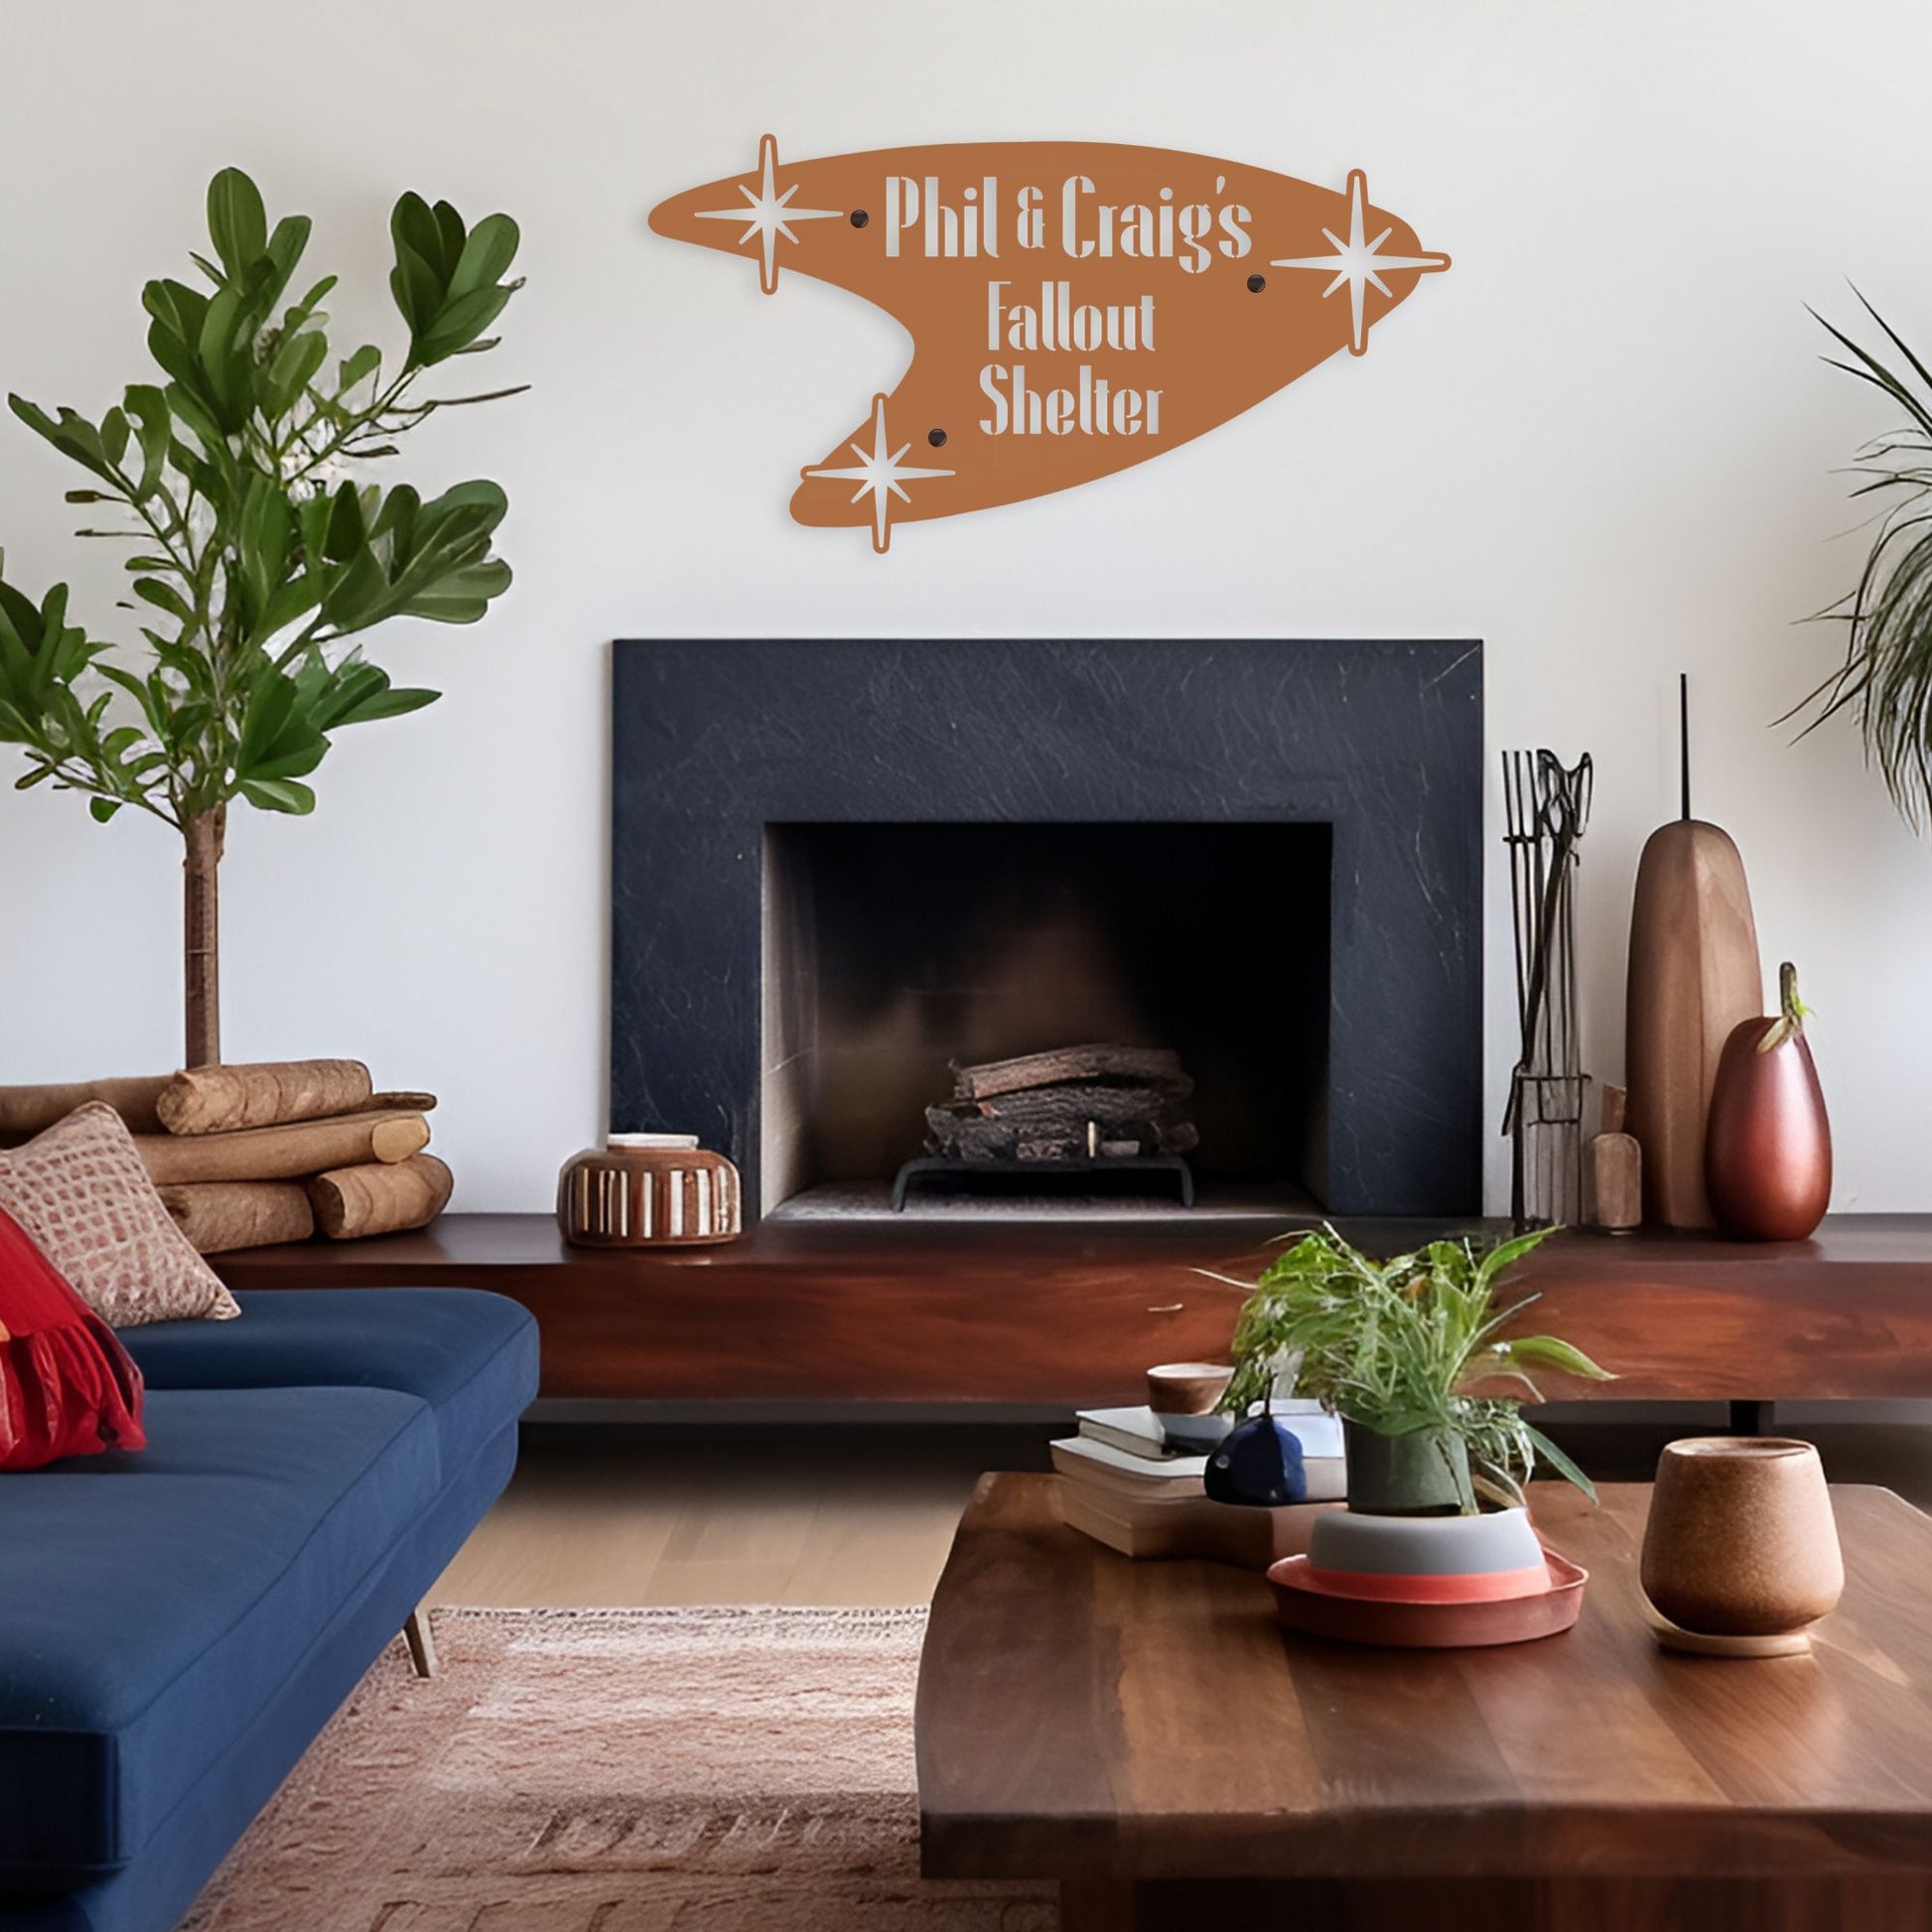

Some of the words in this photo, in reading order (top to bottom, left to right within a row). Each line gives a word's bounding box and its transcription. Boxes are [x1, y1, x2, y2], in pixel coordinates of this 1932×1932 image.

[885, 176, 998, 258] Phil
[1017, 186, 1045, 248] &
[1061, 175, 1252, 274] Craig's
[988, 281, 1156, 351] Fallout
[979, 363, 1162, 436] Shelter
